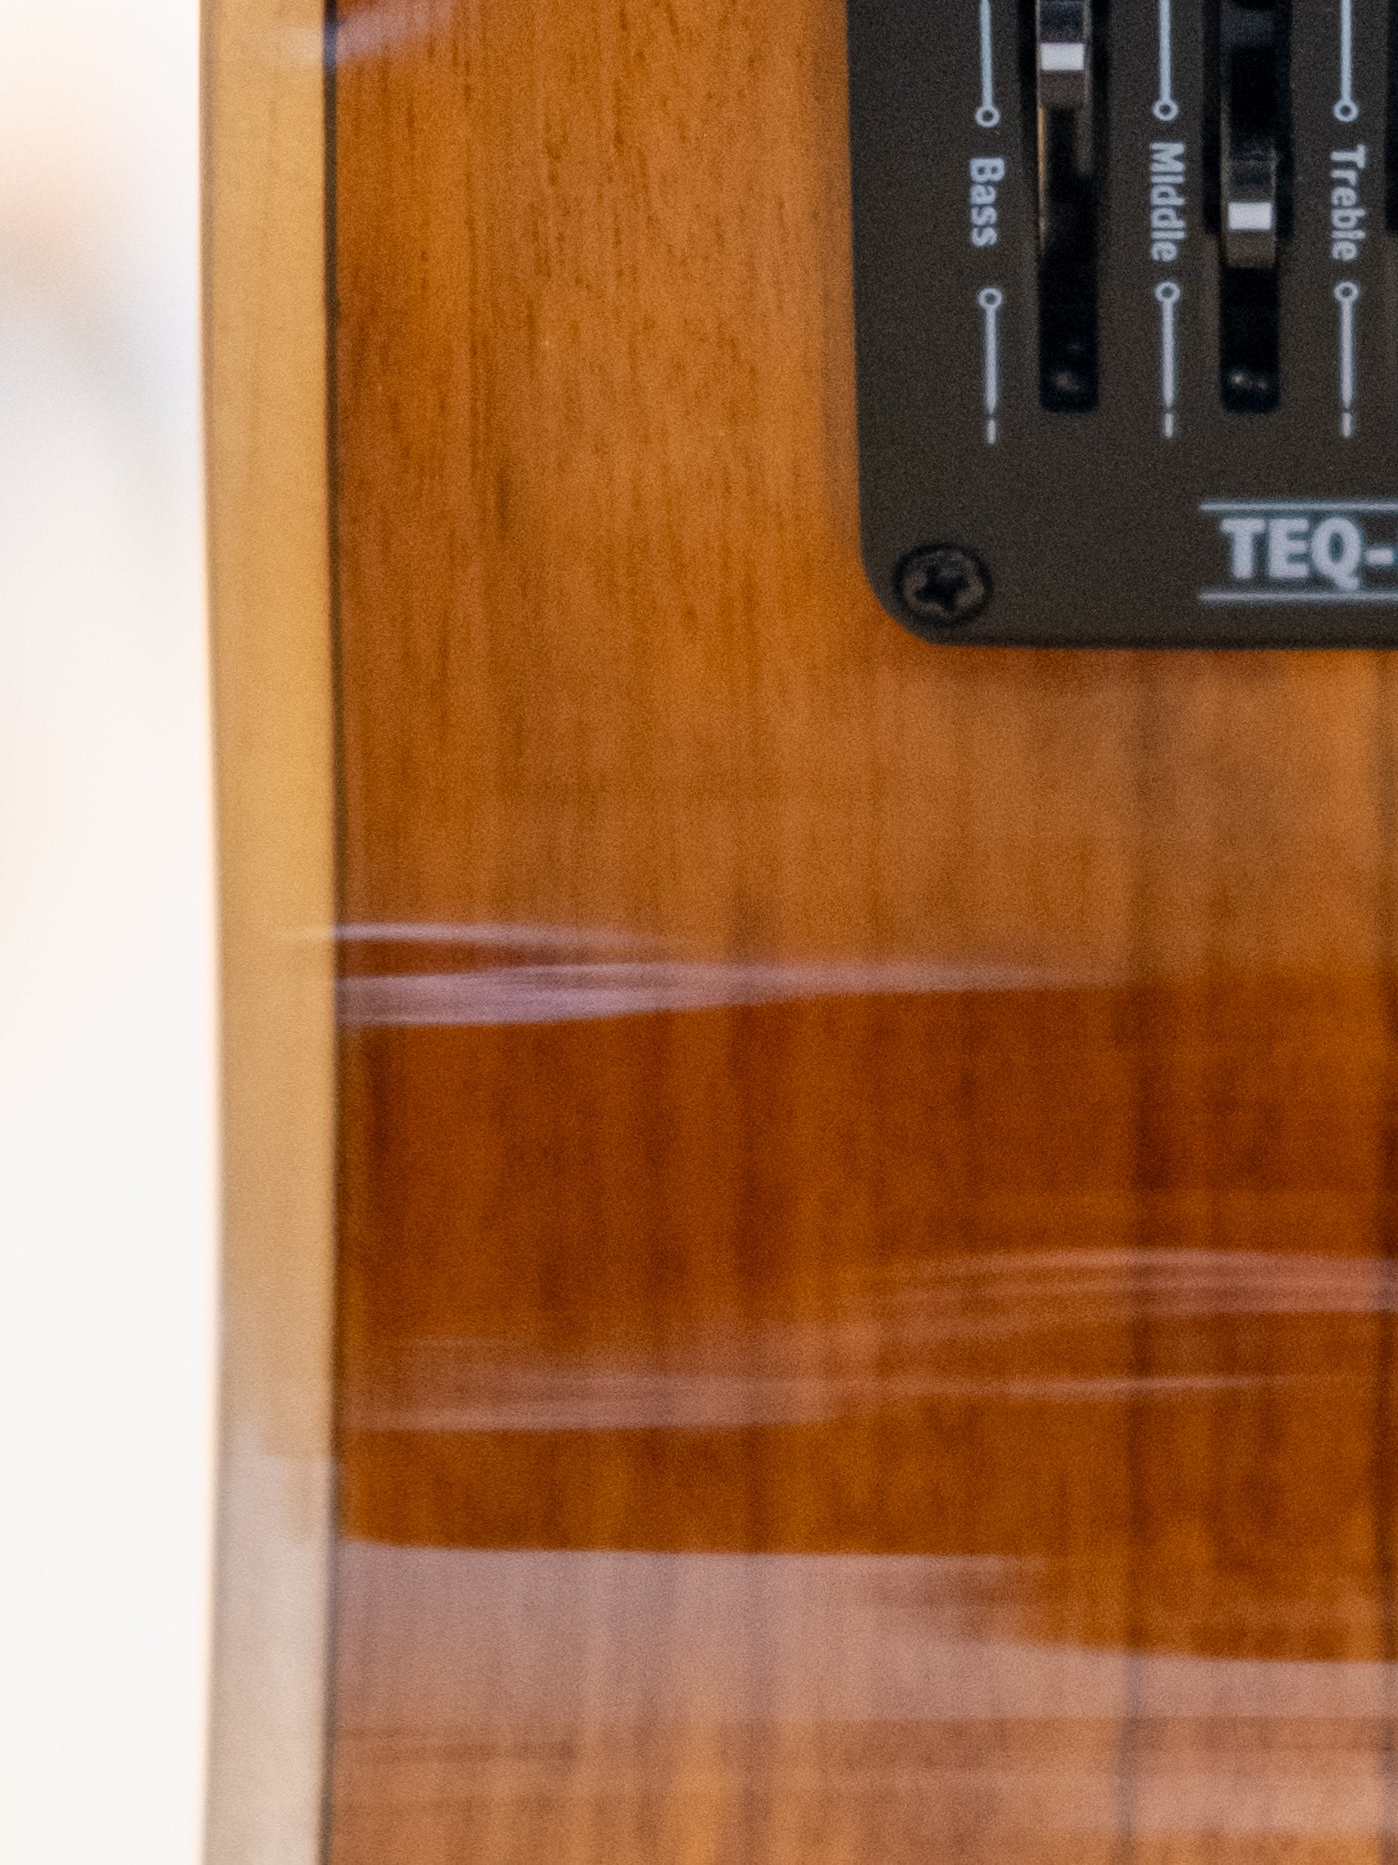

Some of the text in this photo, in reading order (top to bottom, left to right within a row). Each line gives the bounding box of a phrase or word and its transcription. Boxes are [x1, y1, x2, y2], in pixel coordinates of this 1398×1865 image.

[969, 156, 1006, 247] Bass
[1150, 141, 1186, 262] Middle
[1330, 144, 1367, 261] Treble
